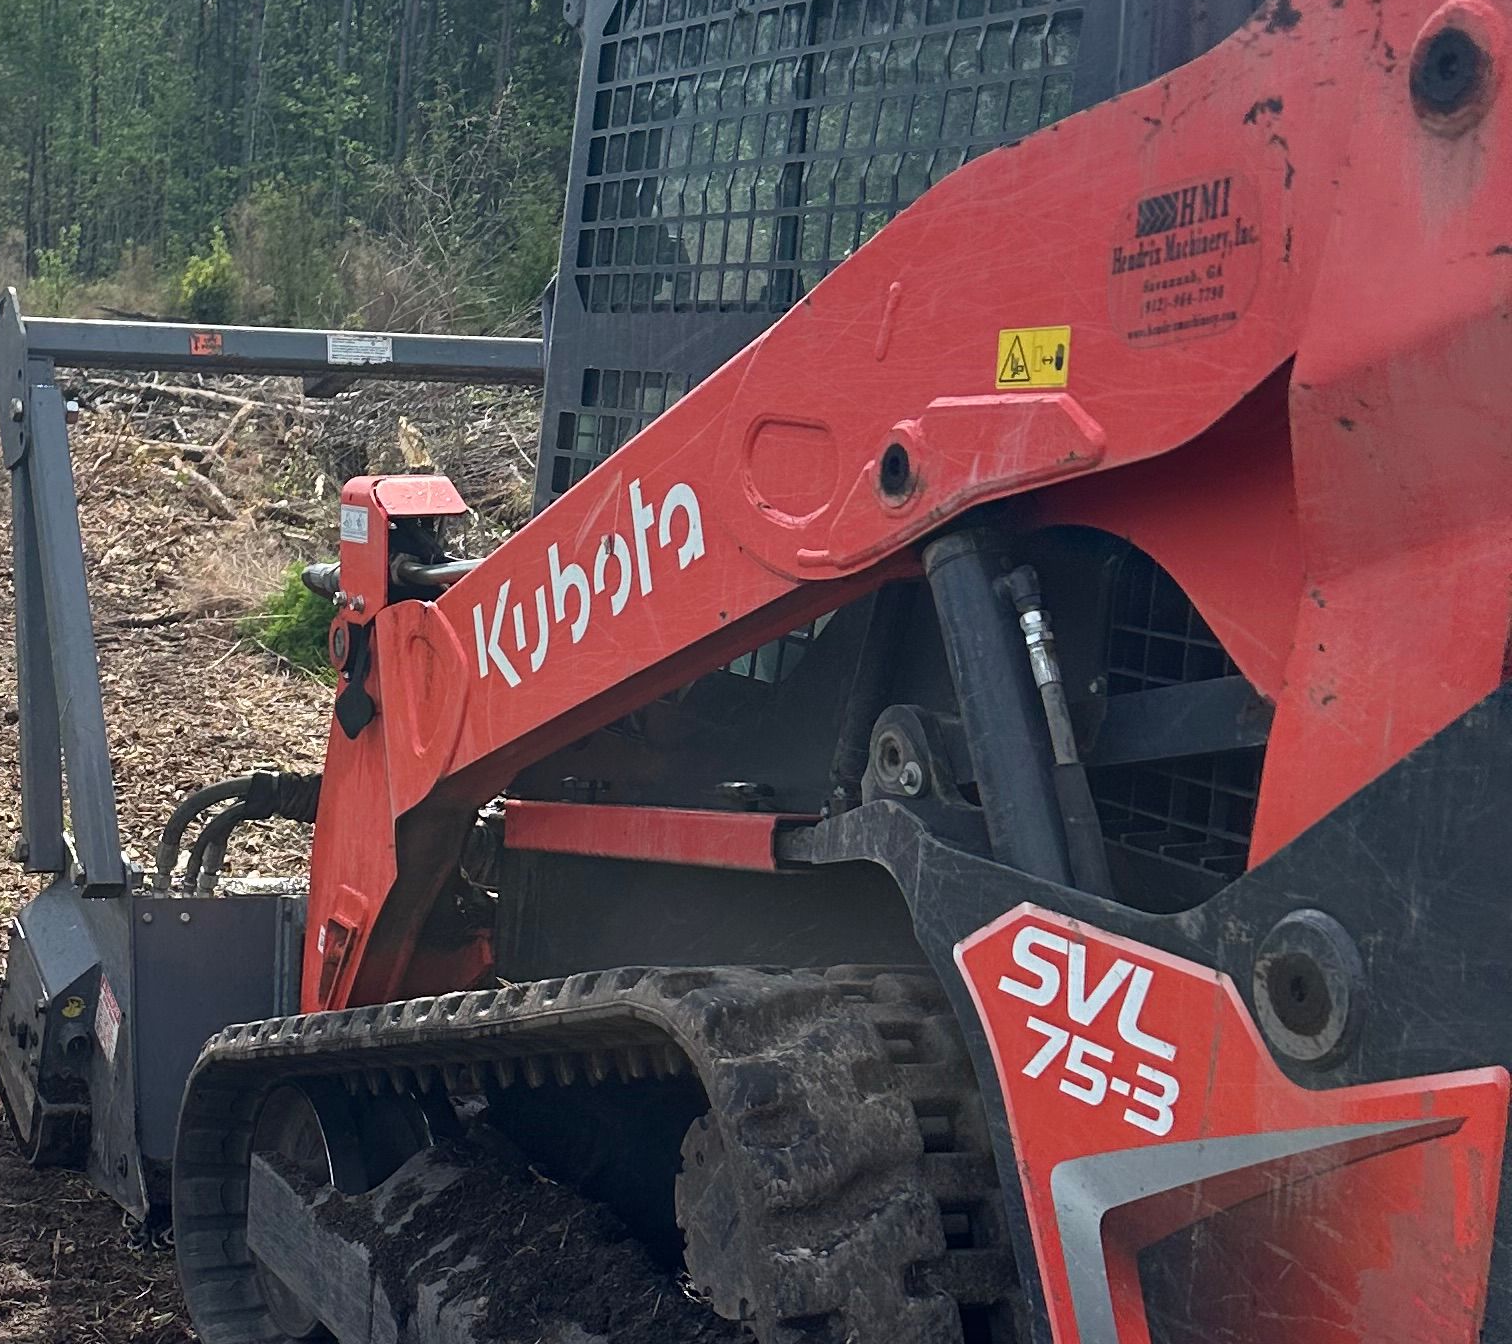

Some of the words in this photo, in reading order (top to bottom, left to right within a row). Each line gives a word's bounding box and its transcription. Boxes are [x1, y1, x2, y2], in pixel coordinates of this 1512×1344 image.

[1112, 239, 1162, 275] Hendrix
[1163, 228, 1233, 261] Machinery,
[1235, 217, 1259, 246] Inc.
[1179, 176, 1232, 227] HMI
[1206, 264, 1223, 279] GA
[472, 477, 705, 688] Kubota
[997, 925, 1177, 1062] SVL
[1021, 1016, 1180, 1137] 75-3
